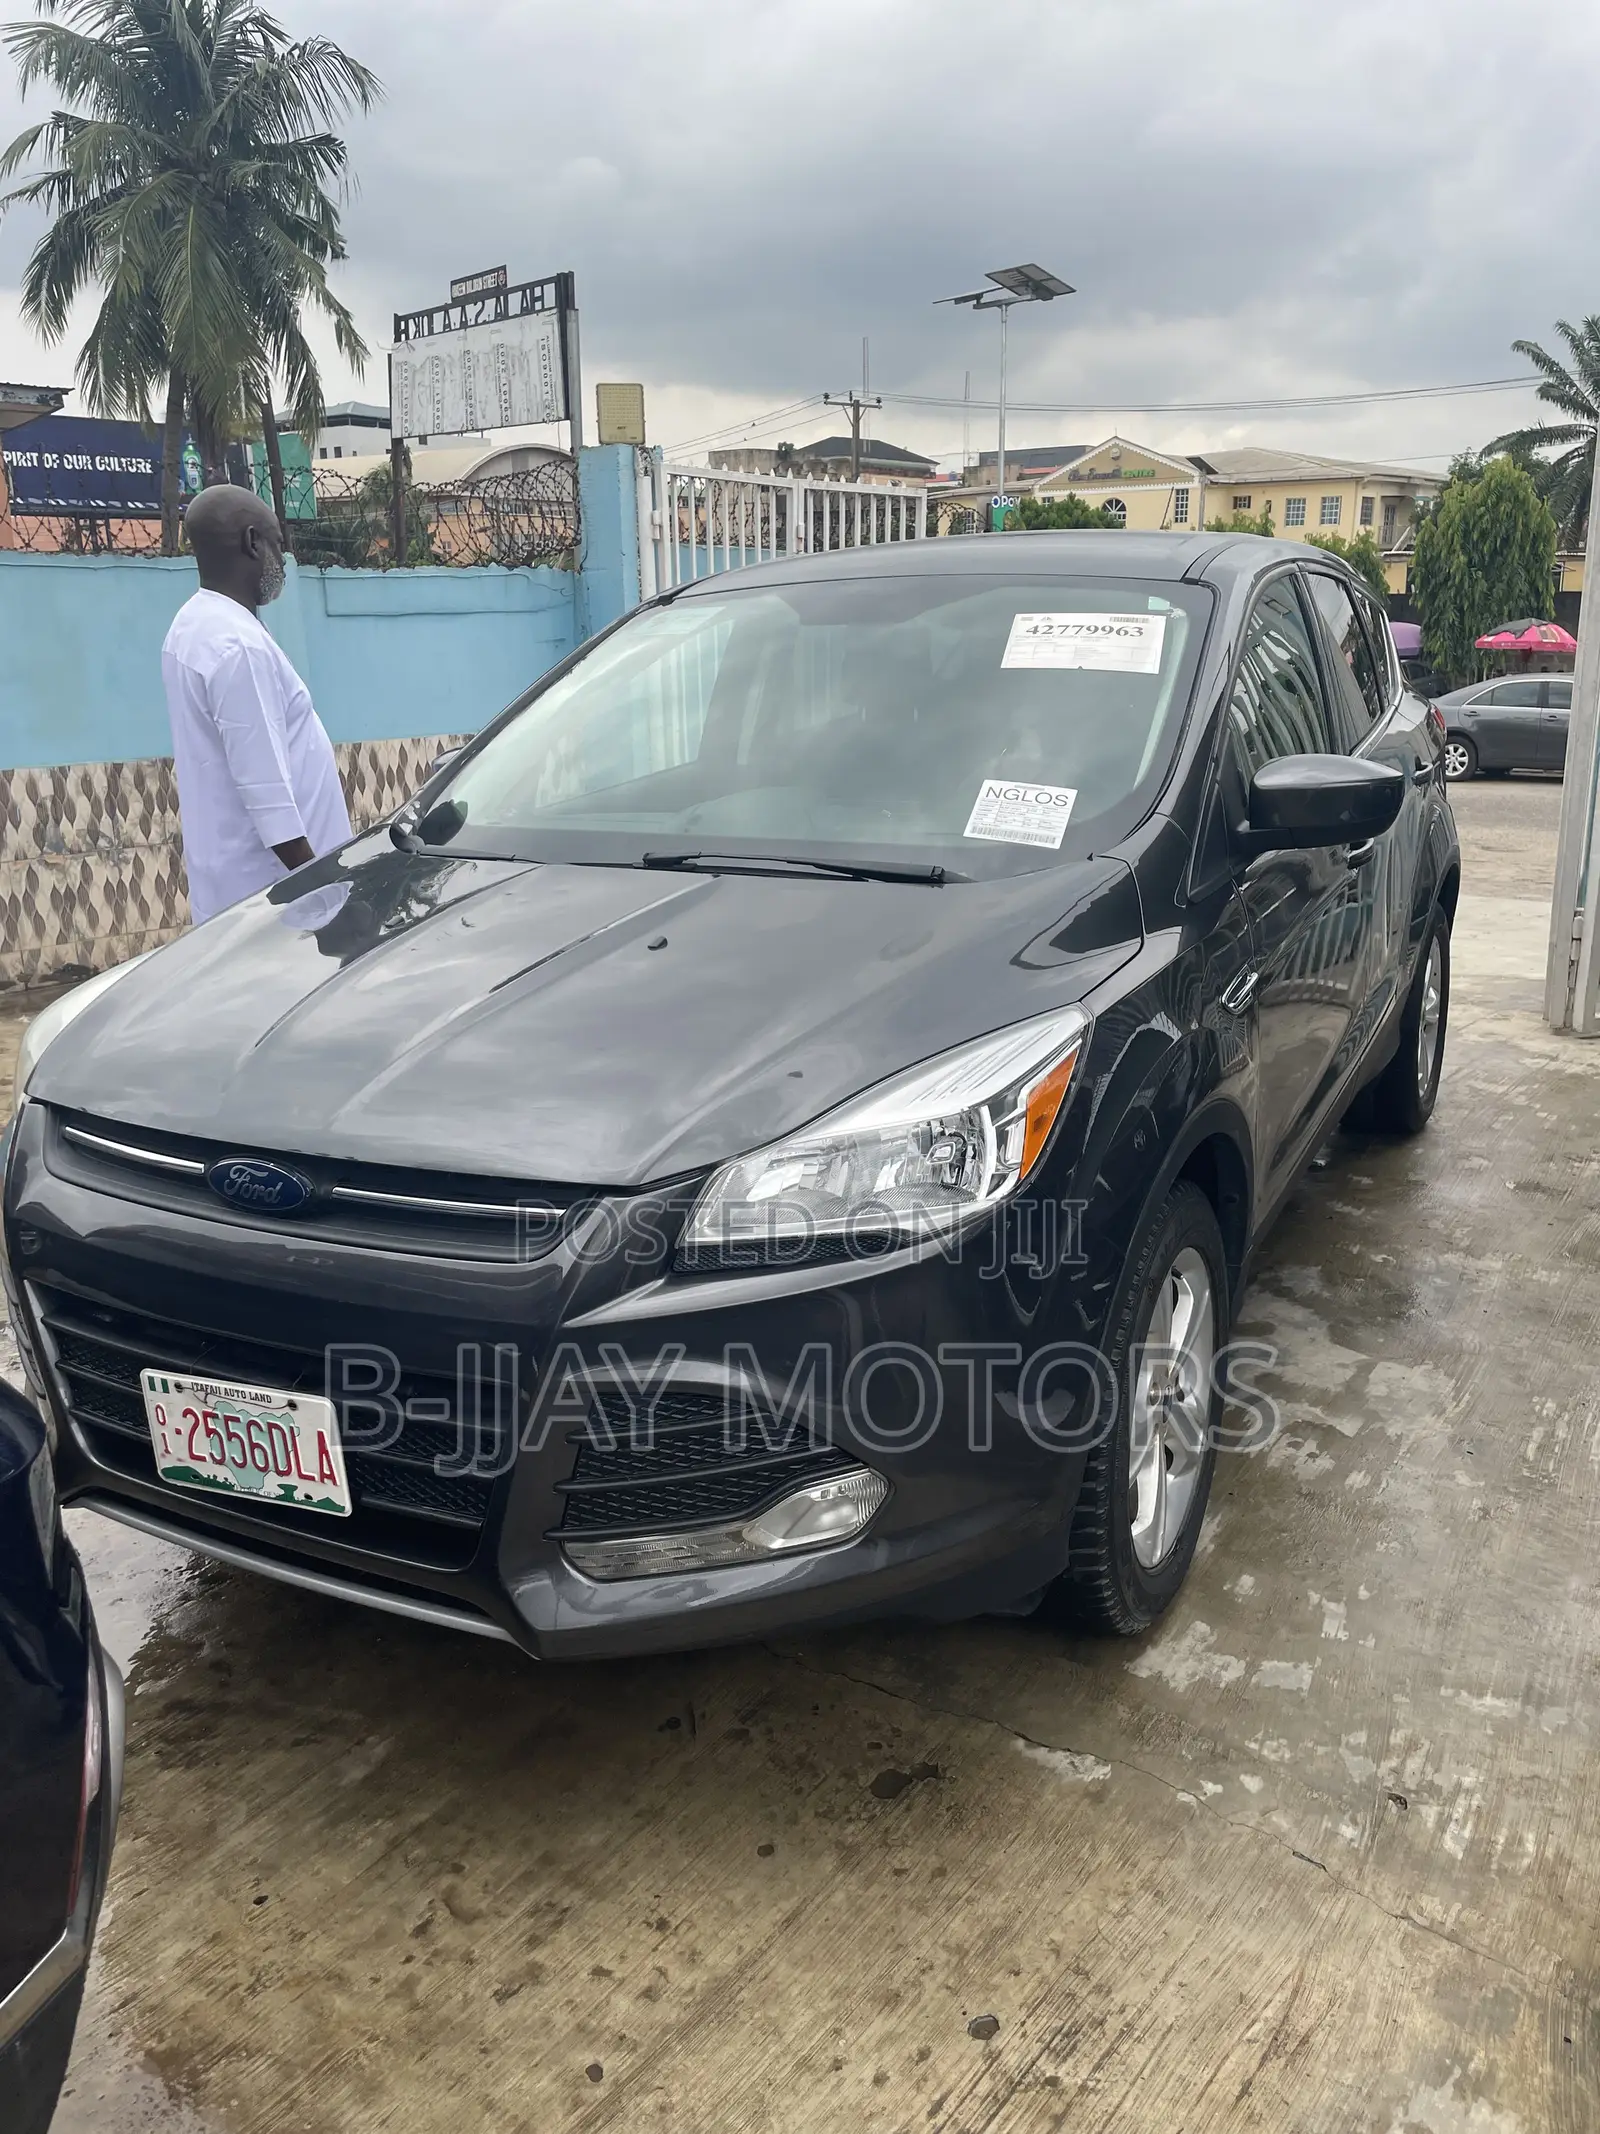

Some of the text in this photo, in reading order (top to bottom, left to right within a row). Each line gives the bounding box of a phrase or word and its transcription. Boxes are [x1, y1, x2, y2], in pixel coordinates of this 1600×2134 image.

[3, 451, 153, 474] PIRIT OF OUR CULTURE
[1025, 624, 1144, 637] 42779963
[985, 786, 1069, 807] NGLOS
[223, 1164, 283, 1204] Ford
[224, 1387, 247, 1399] AUTO
[249, 1391, 272, 1404] LAND
